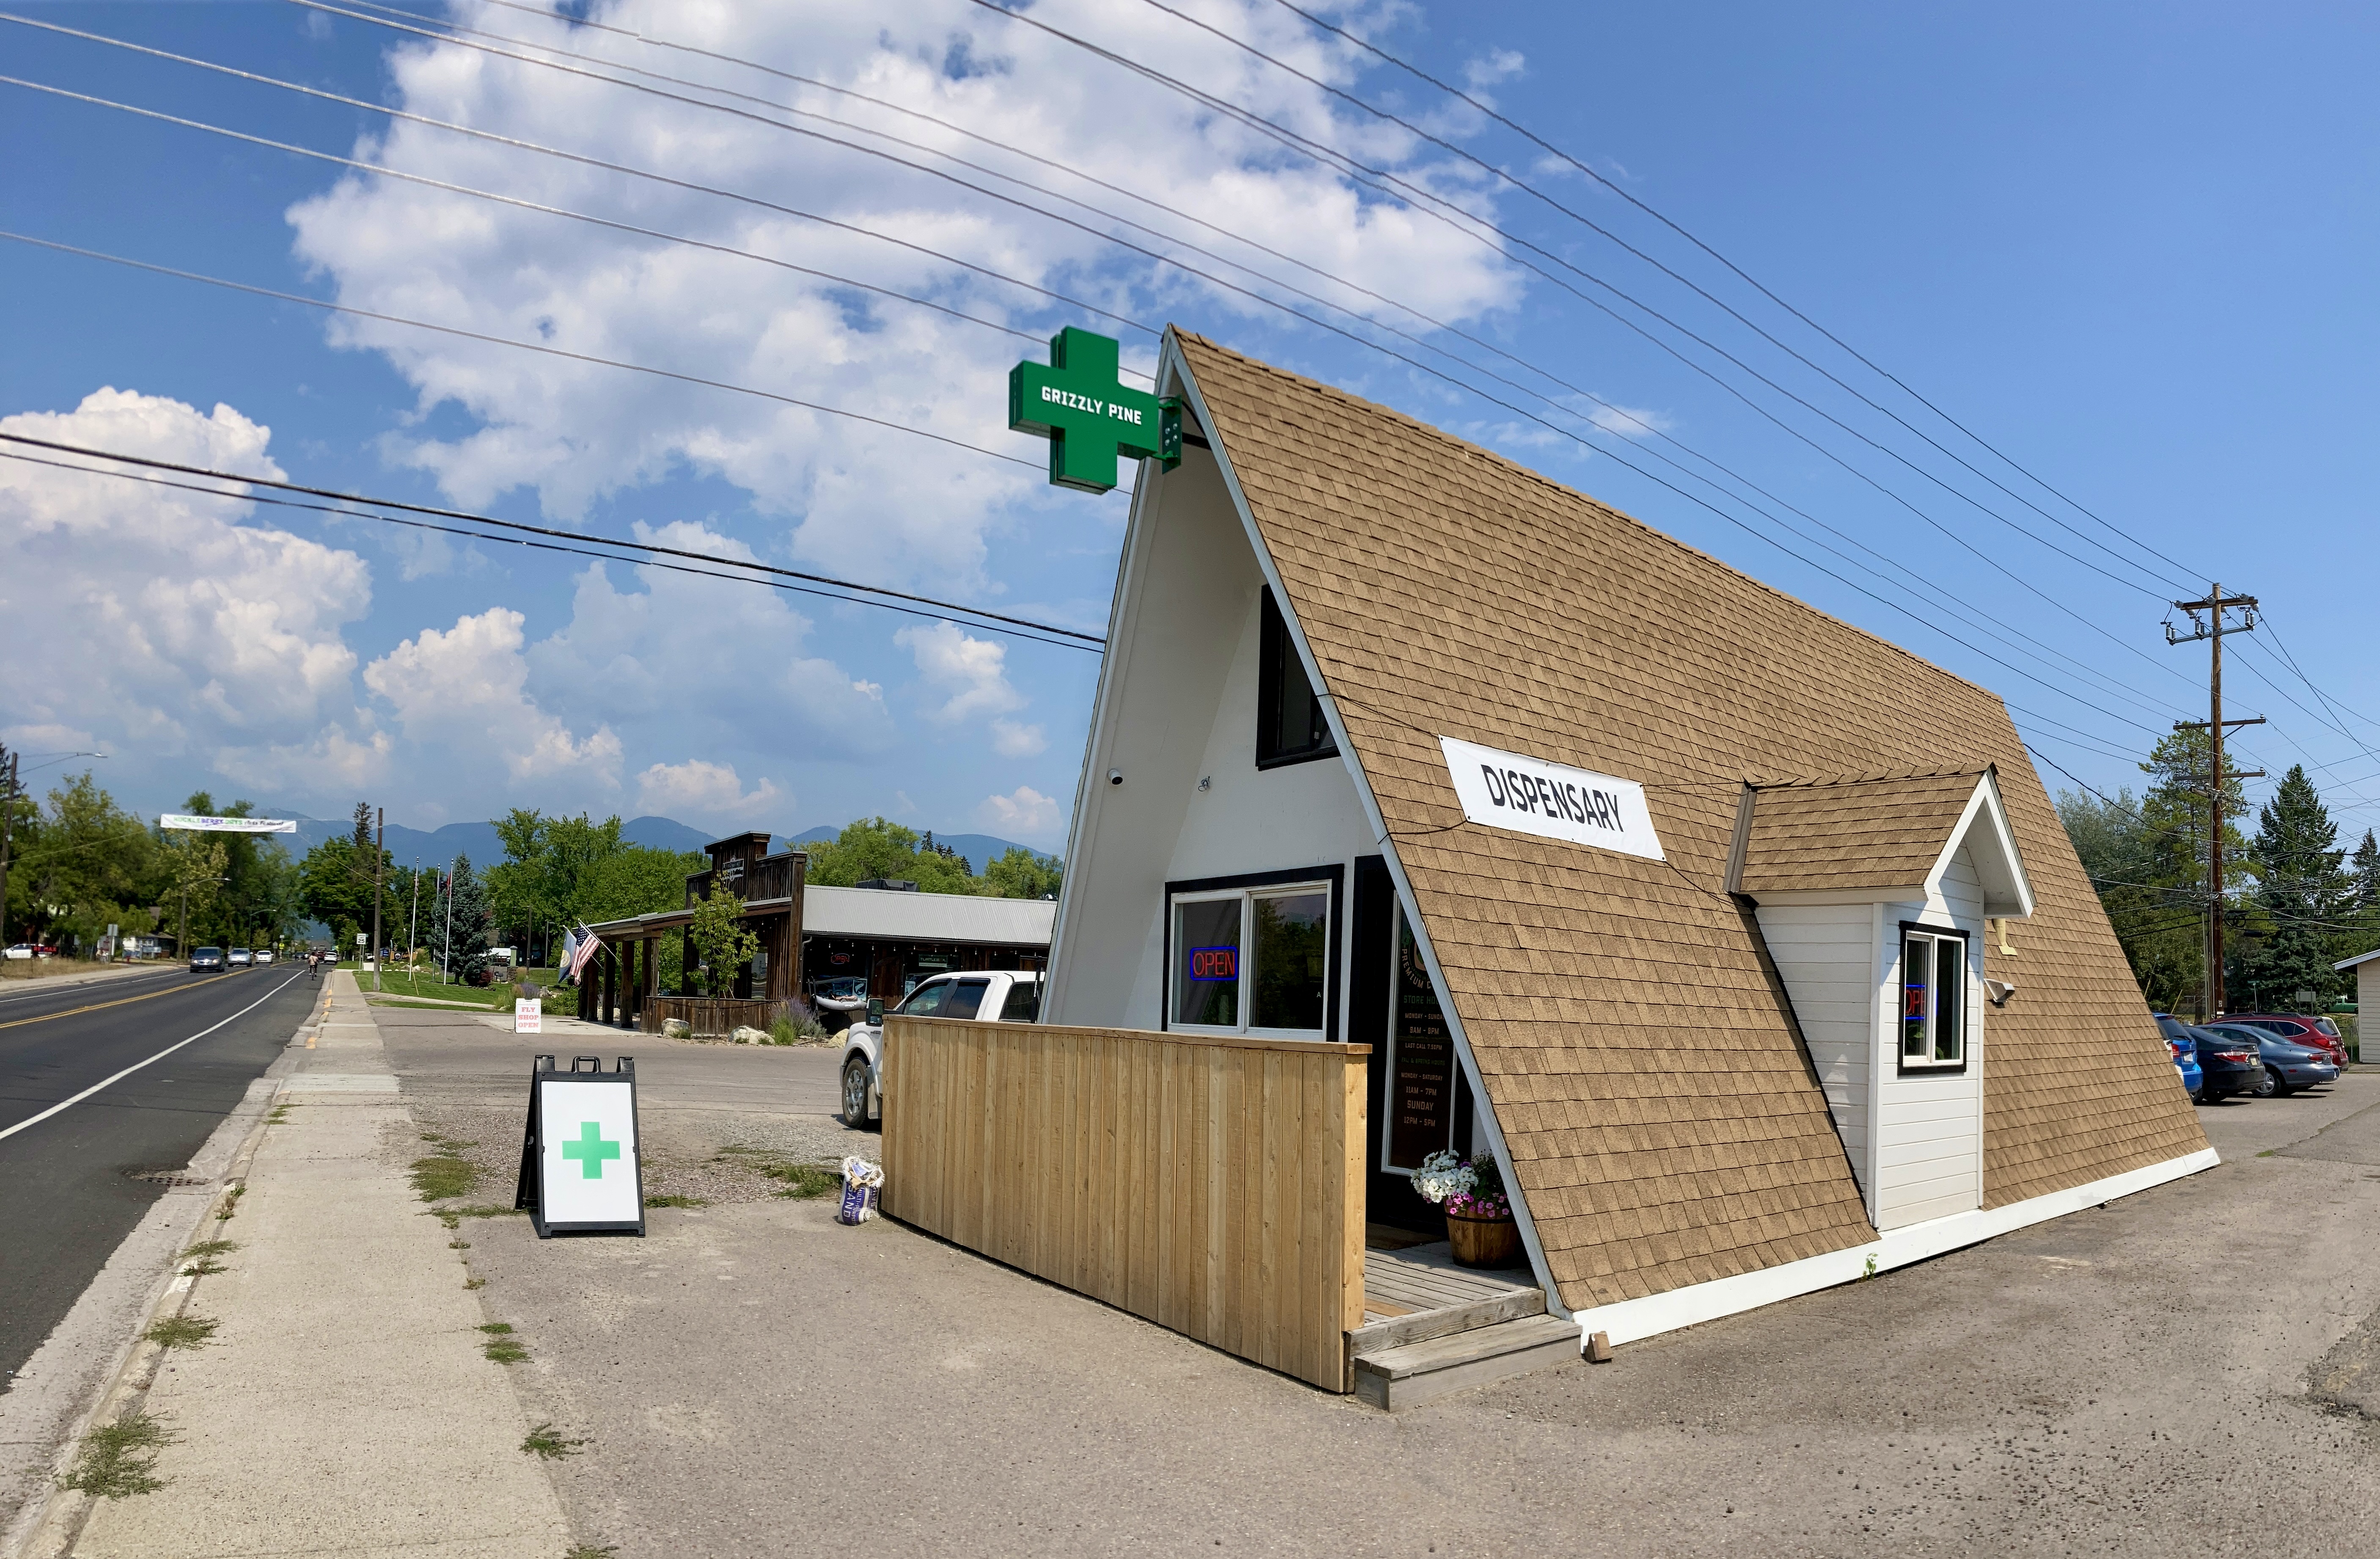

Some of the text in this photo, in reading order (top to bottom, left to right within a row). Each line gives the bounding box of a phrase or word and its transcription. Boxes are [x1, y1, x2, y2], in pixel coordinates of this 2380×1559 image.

[1042, 385, 1142, 426] GRIZZLY PINE
[1481, 764, 1624, 833] DISPENSARY
[1193, 952, 1235, 976] OPEN
[1402, 949, 1424, 989] PREMIUM
[1404, 995, 1424, 1004] STORE
[1906, 990, 1926, 1014] OPE
[1406, 1086, 1418, 1094] 11AM
[1425, 1088, 1437, 1096] 7PM
[1407, 1100, 1434, 1111] SUNDAY
[1404, 1116, 1418, 1125] 12PM
[1424, 1118, 1435, 1127] 5PM
